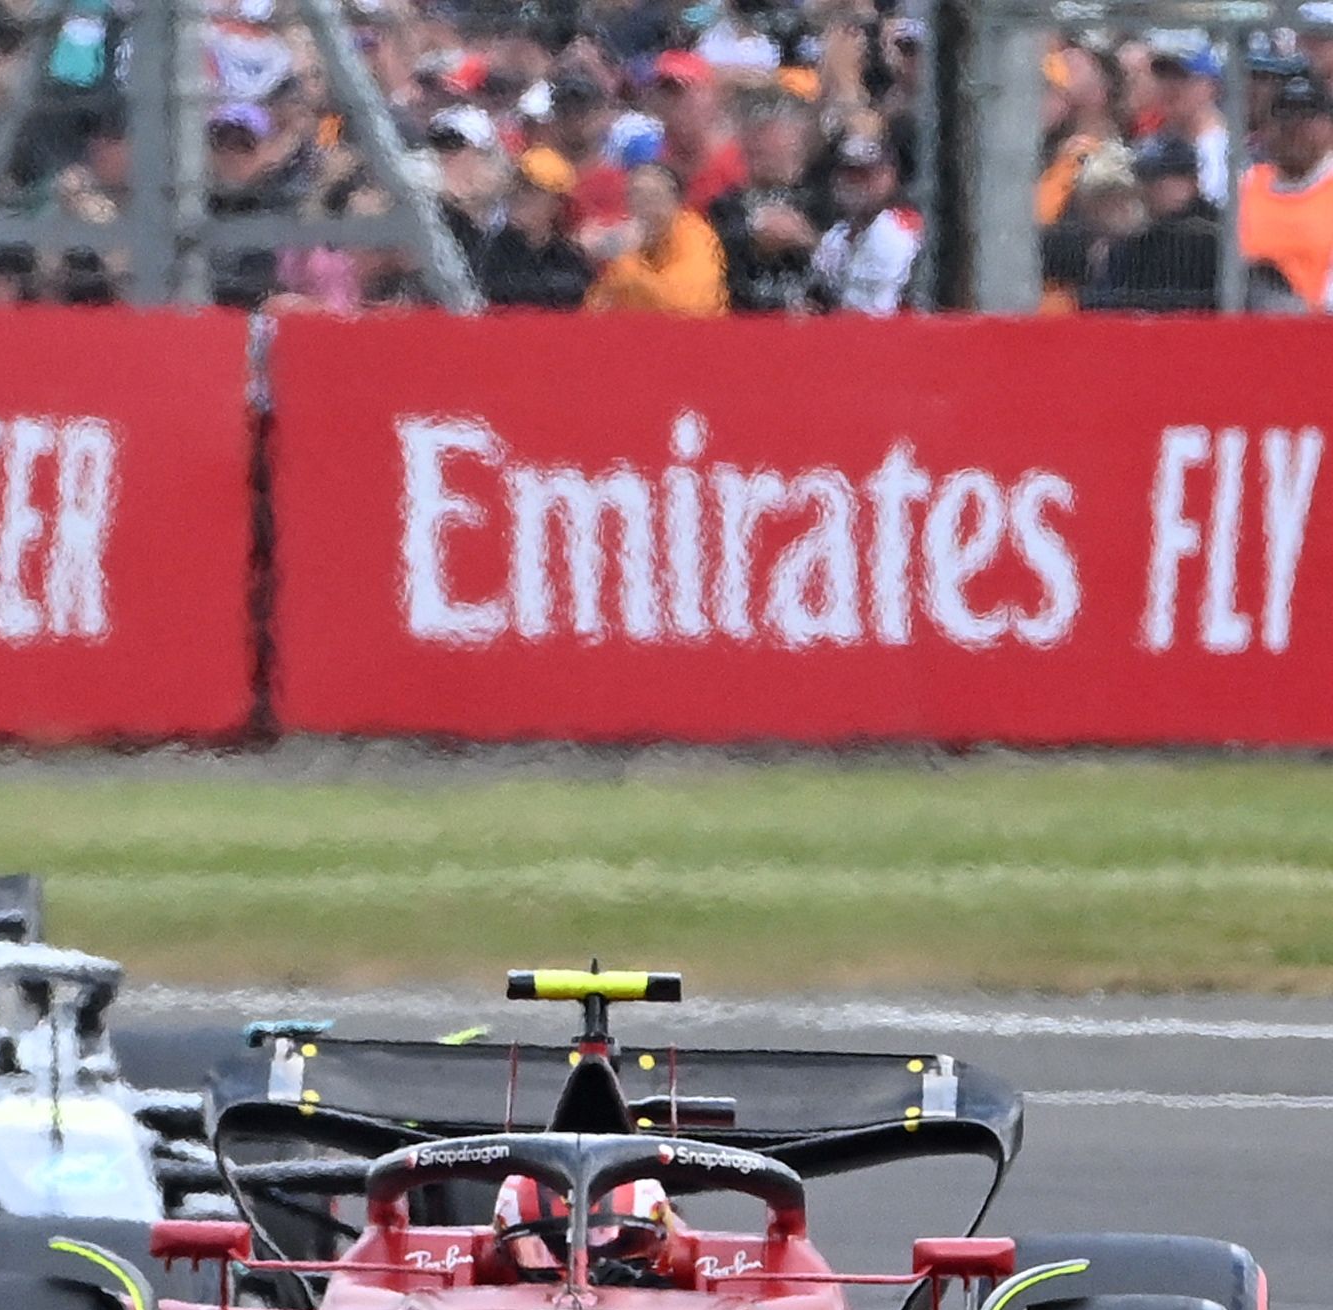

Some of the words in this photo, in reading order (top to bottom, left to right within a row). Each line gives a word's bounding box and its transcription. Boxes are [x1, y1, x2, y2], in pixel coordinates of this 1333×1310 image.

[395, 406, 1081, 652] Emirates
[1139, 422, 1325, 655] FLY
[416, 1142, 510, 1169] Snapdragon
[675, 1149, 767, 1174] Snapdragon
